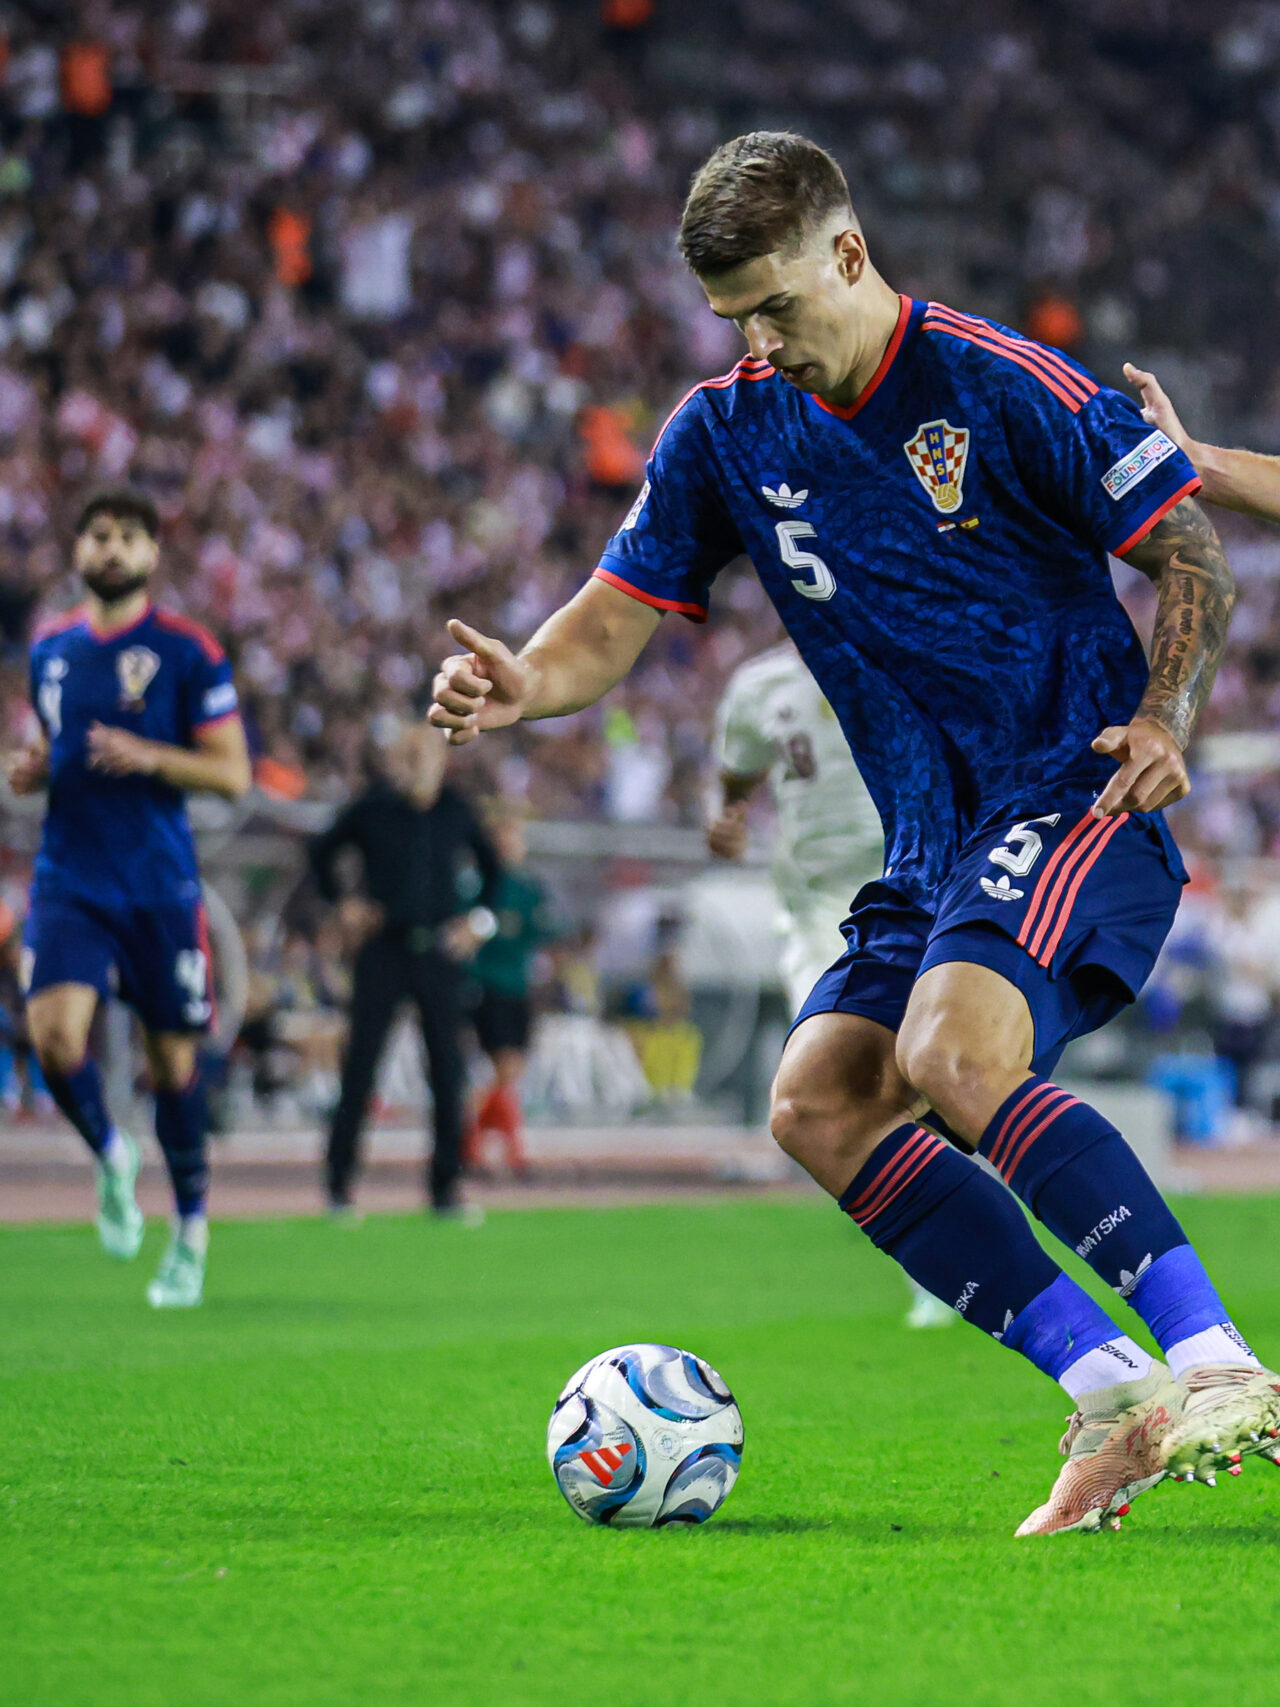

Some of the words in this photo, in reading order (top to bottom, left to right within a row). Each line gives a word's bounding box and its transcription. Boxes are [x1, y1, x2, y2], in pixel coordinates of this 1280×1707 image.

[929, 432, 946, 476] HNS
[1106, 437, 1169, 492] FOUNDATION
[774, 520, 837, 601] 5
[988, 812, 1061, 877] 5
